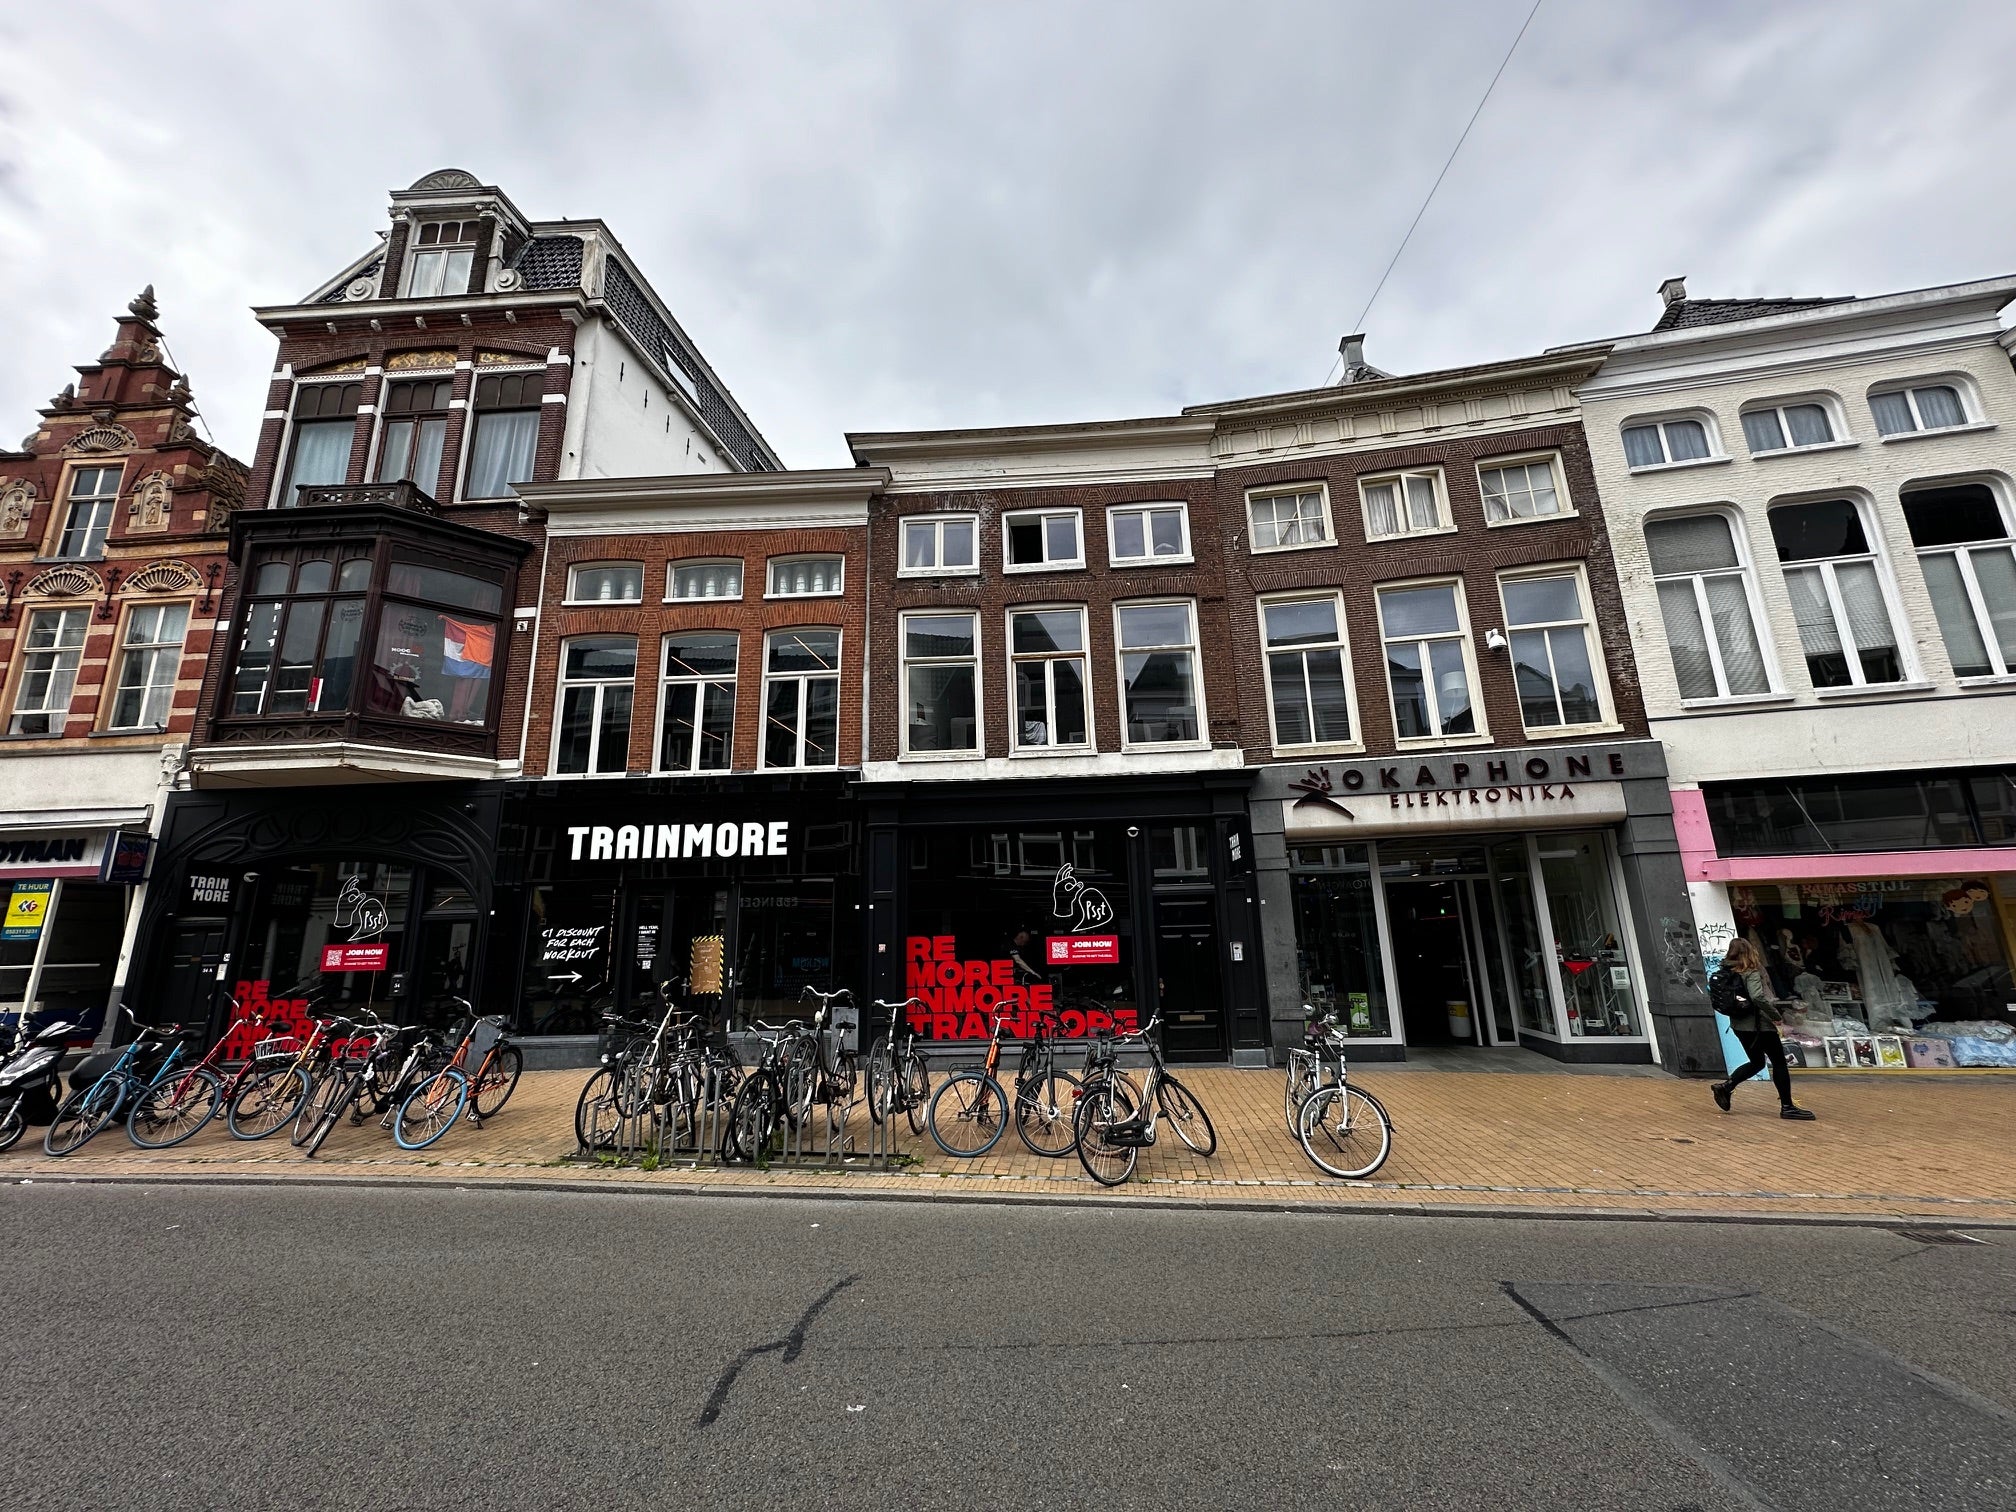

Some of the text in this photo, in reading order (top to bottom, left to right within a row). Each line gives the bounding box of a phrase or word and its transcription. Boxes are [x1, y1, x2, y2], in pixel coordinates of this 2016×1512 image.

[1342, 753, 1624, 790] OKAPHONE
[1390, 784, 1575, 808] ELEKTRONIKA
[568, 821, 789, 860] TRAINMORE
[190, 875, 230, 890] TRAIN
[192, 888, 231, 902] MORE
[364, 911, 383, 929] Psst
[1086, 900, 1106, 920] Psst
[555, 925, 605, 938] DISCOUNT
[546, 937, 595, 948] FOR EACH
[906, 935, 956, 961] RE
[542, 946, 600, 962] WORKOUT
[906, 960, 1014, 987] MORE
[234, 980, 271, 1000] RE
[906, 984, 1053, 1013] INMORE
[229, 999, 308, 1020] MORE
